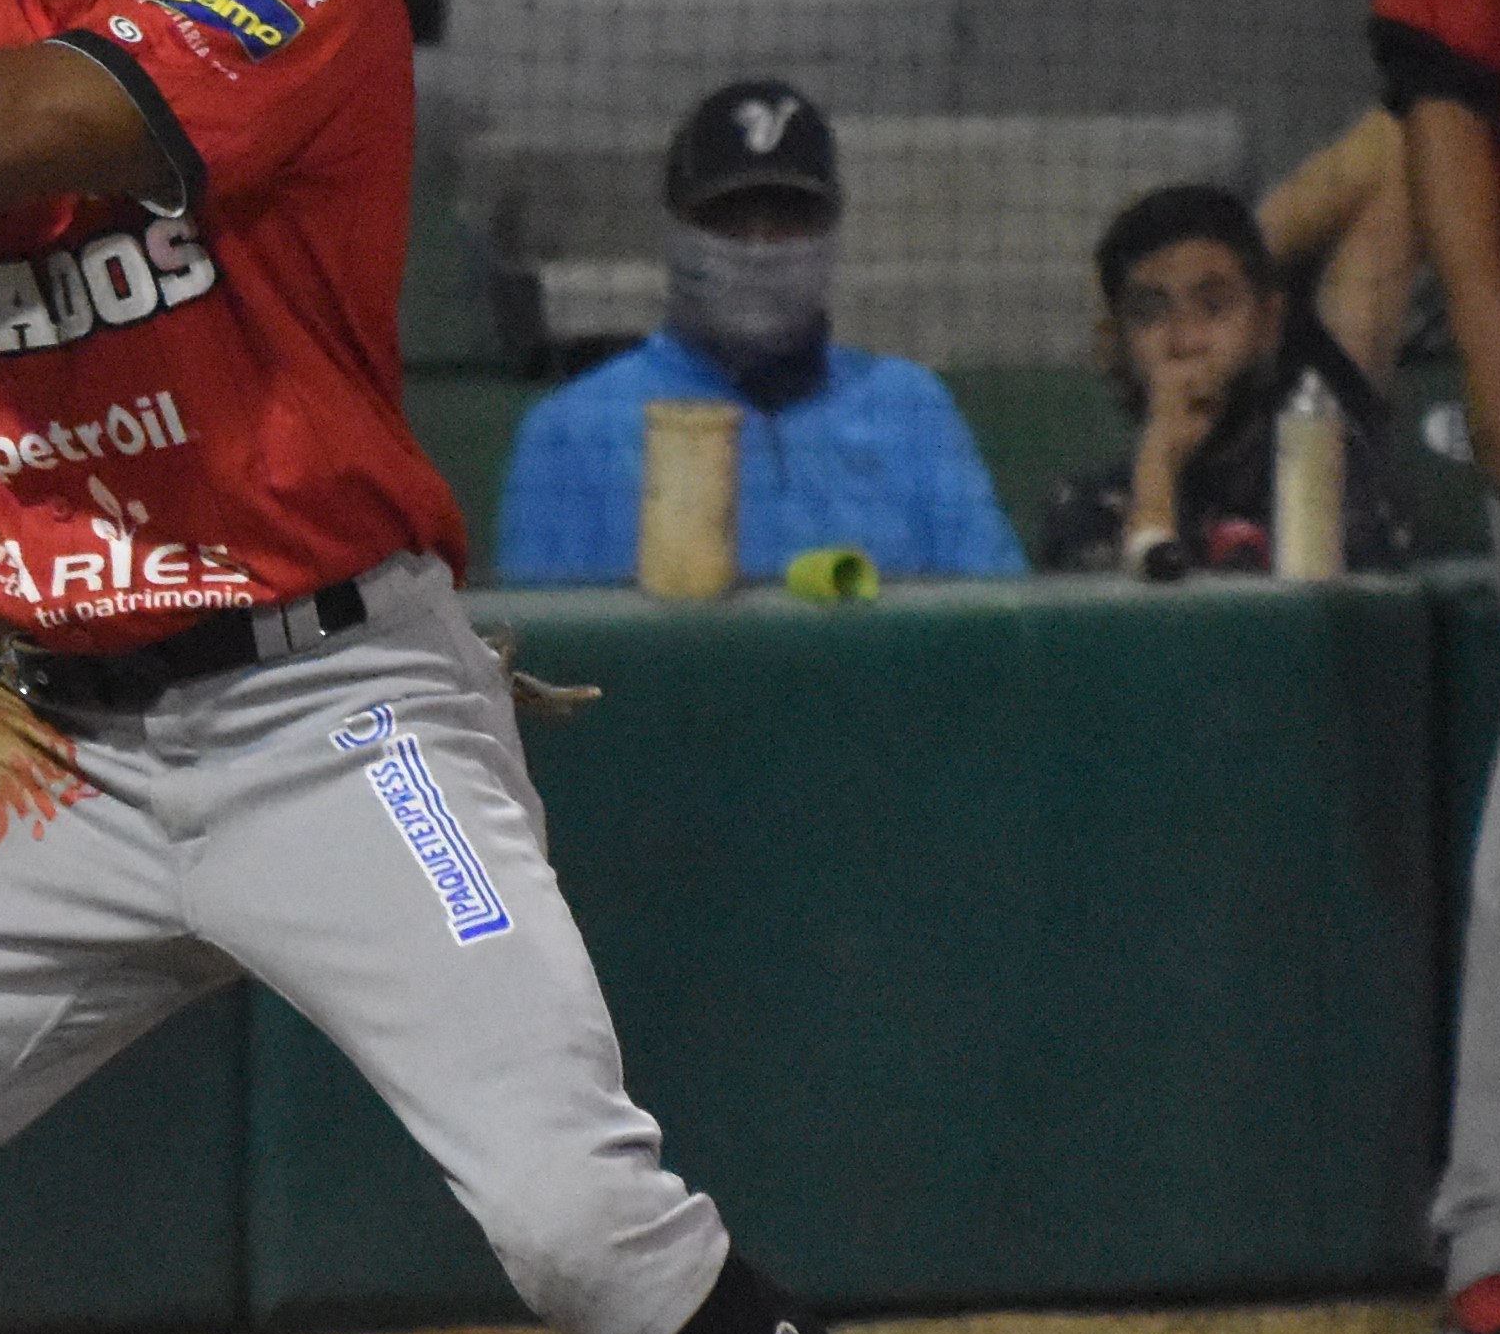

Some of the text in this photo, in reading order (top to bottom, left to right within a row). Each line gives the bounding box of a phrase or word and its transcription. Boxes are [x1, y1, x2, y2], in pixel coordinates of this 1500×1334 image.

[35, 604, 69, 628] tu
[74, 585, 253, 623] patrimonio
[371, 759, 480, 917] PAQUETEXPRESS
